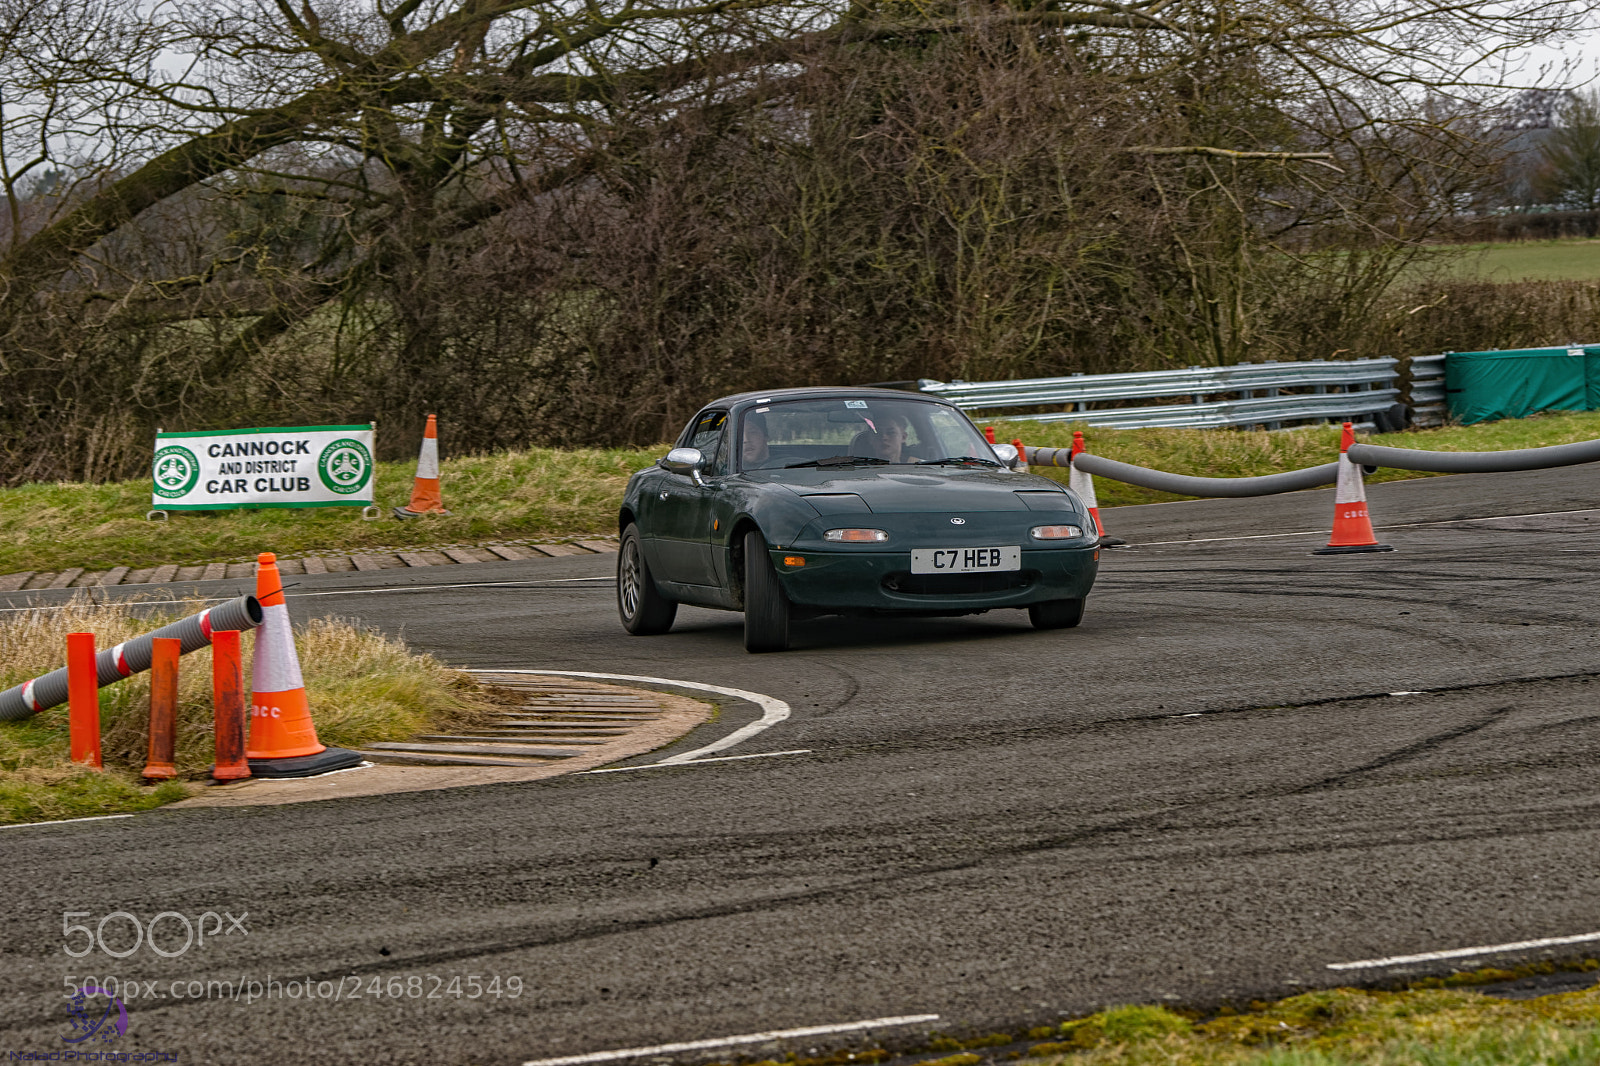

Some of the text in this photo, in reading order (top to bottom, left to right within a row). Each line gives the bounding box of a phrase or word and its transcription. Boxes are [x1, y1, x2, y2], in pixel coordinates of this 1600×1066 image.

[208, 440, 310, 457] CANNOCK
[219, 460, 297, 475] AND DISTRICT
[206, 477, 310, 494] CAR CLUB
[934, 549, 1000, 568] C7 HEB
